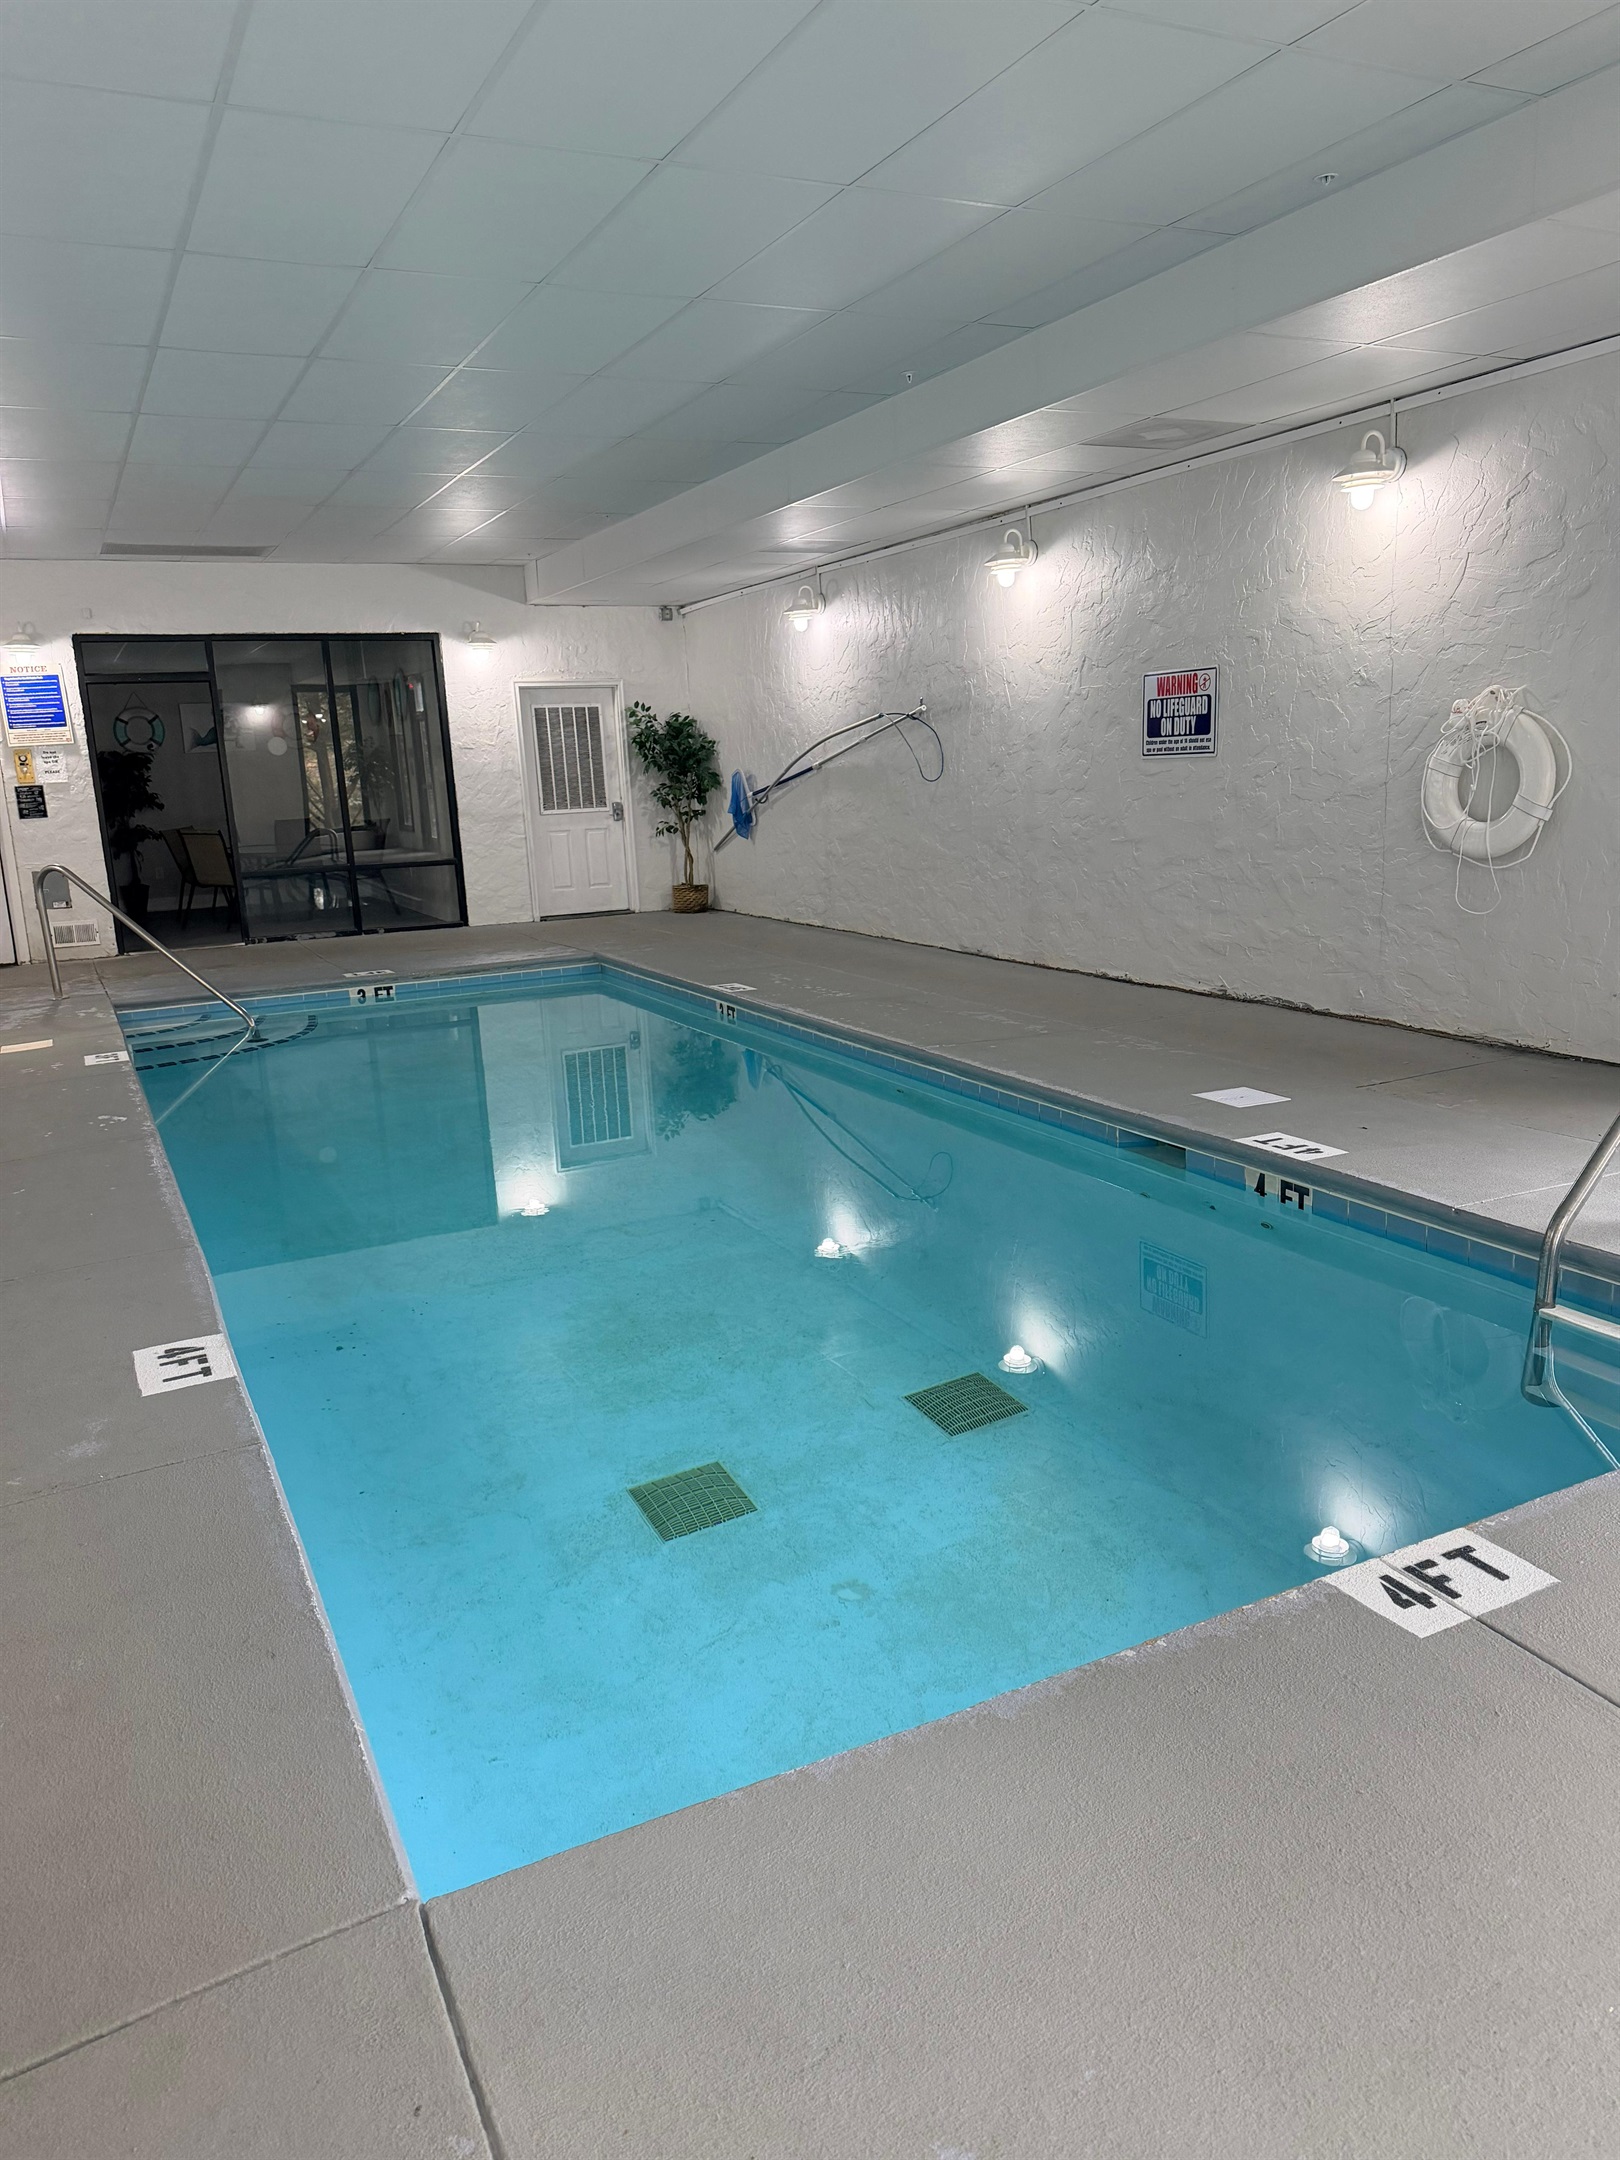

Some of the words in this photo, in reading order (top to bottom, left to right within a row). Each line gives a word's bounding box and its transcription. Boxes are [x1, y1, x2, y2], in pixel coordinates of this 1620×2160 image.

[9, 665, 48, 674] NOTICE
[1157, 672, 1198, 697] WARNING
[1150, 699, 1162, 719] NO
[1163, 695, 1208, 717] LIFEGUARD
[1160, 717, 1173, 737] ON
[1174, 715, 1197, 736] DUTY
[374, 985, 394, 997] FT
[1253, 1172, 1268, 1198] 4
[1280, 1179, 1310, 1211] FT
[157, 1346, 213, 1383] 4FT
[1378, 1545, 1510, 1609] 4FT
